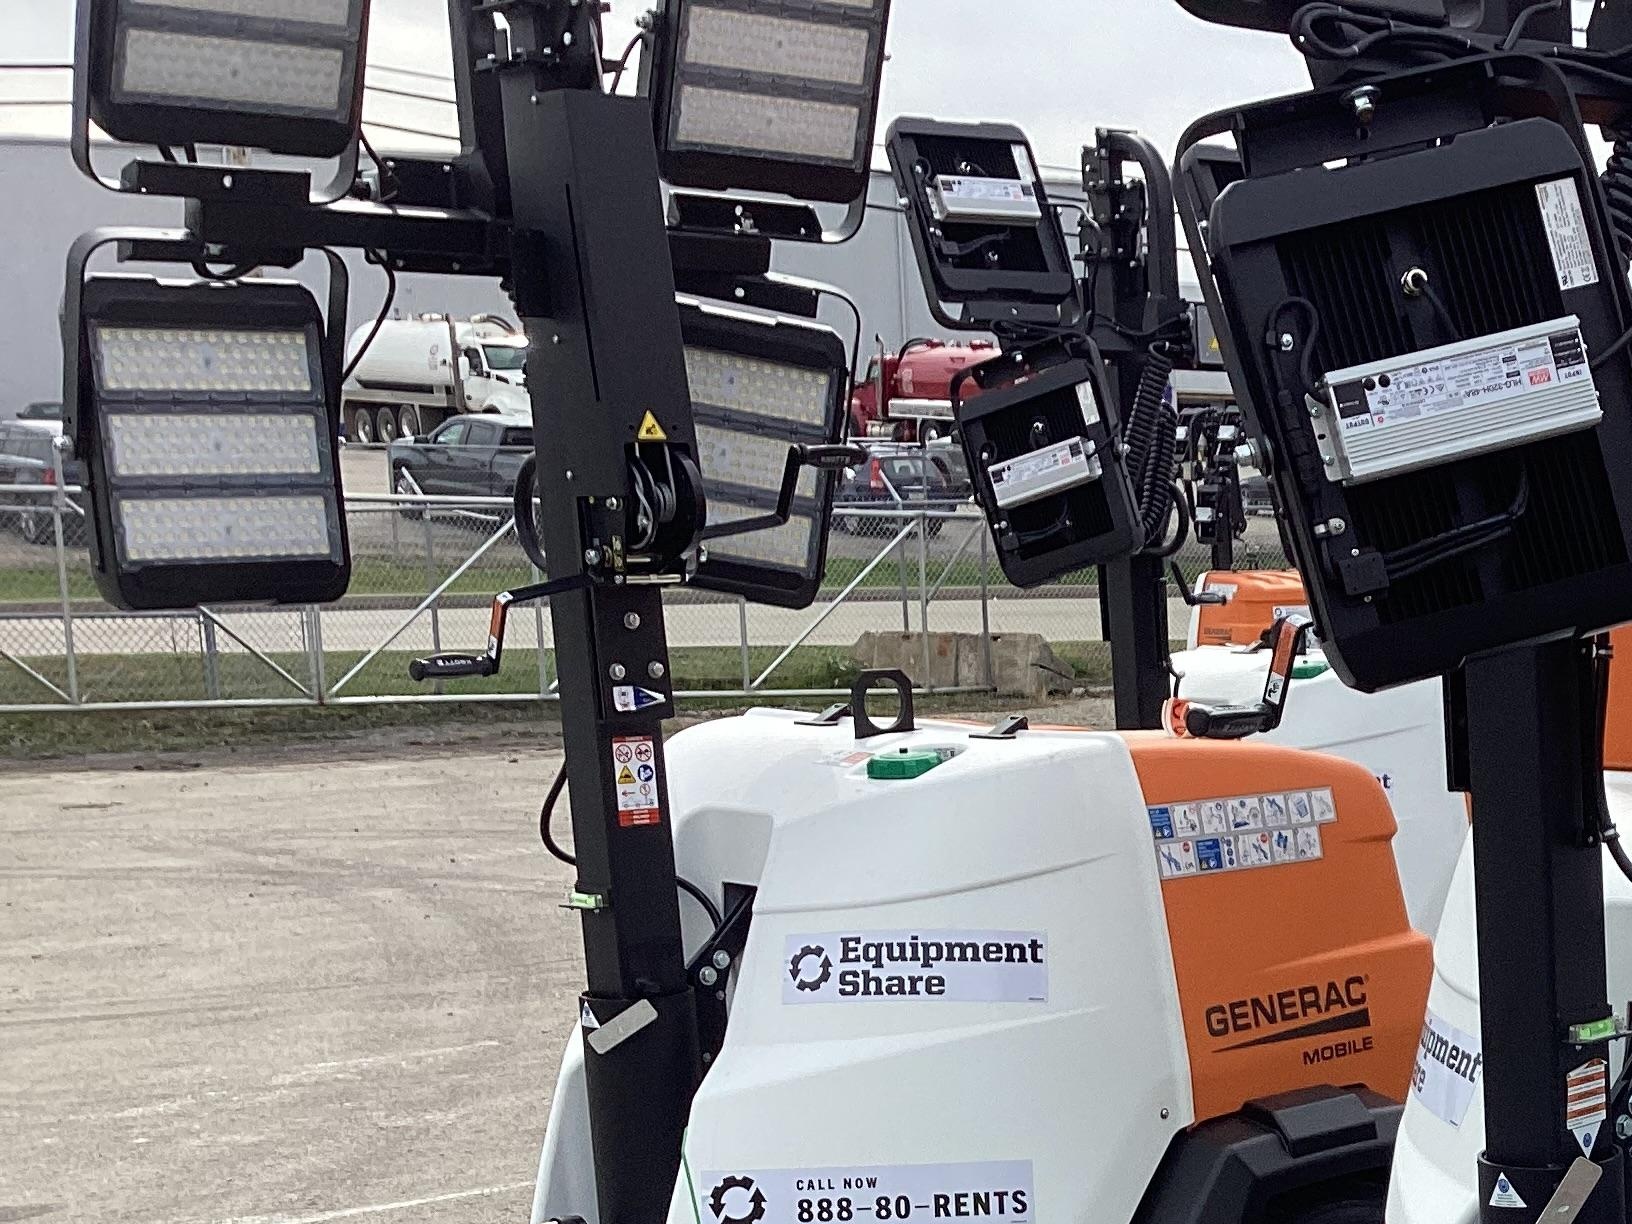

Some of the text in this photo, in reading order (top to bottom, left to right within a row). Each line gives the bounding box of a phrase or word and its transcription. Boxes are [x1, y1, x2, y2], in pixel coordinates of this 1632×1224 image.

[839, 935, 1044, 969] Equipment
[838, 969, 946, 996] Share
[1205, 975, 1368, 1038] GENERAC
[1303, 1036, 1374, 1065] MOBILE
[796, 1176, 879, 1192] CALL NOW
[797, 1189, 1029, 1224] 888-80-RENTS
